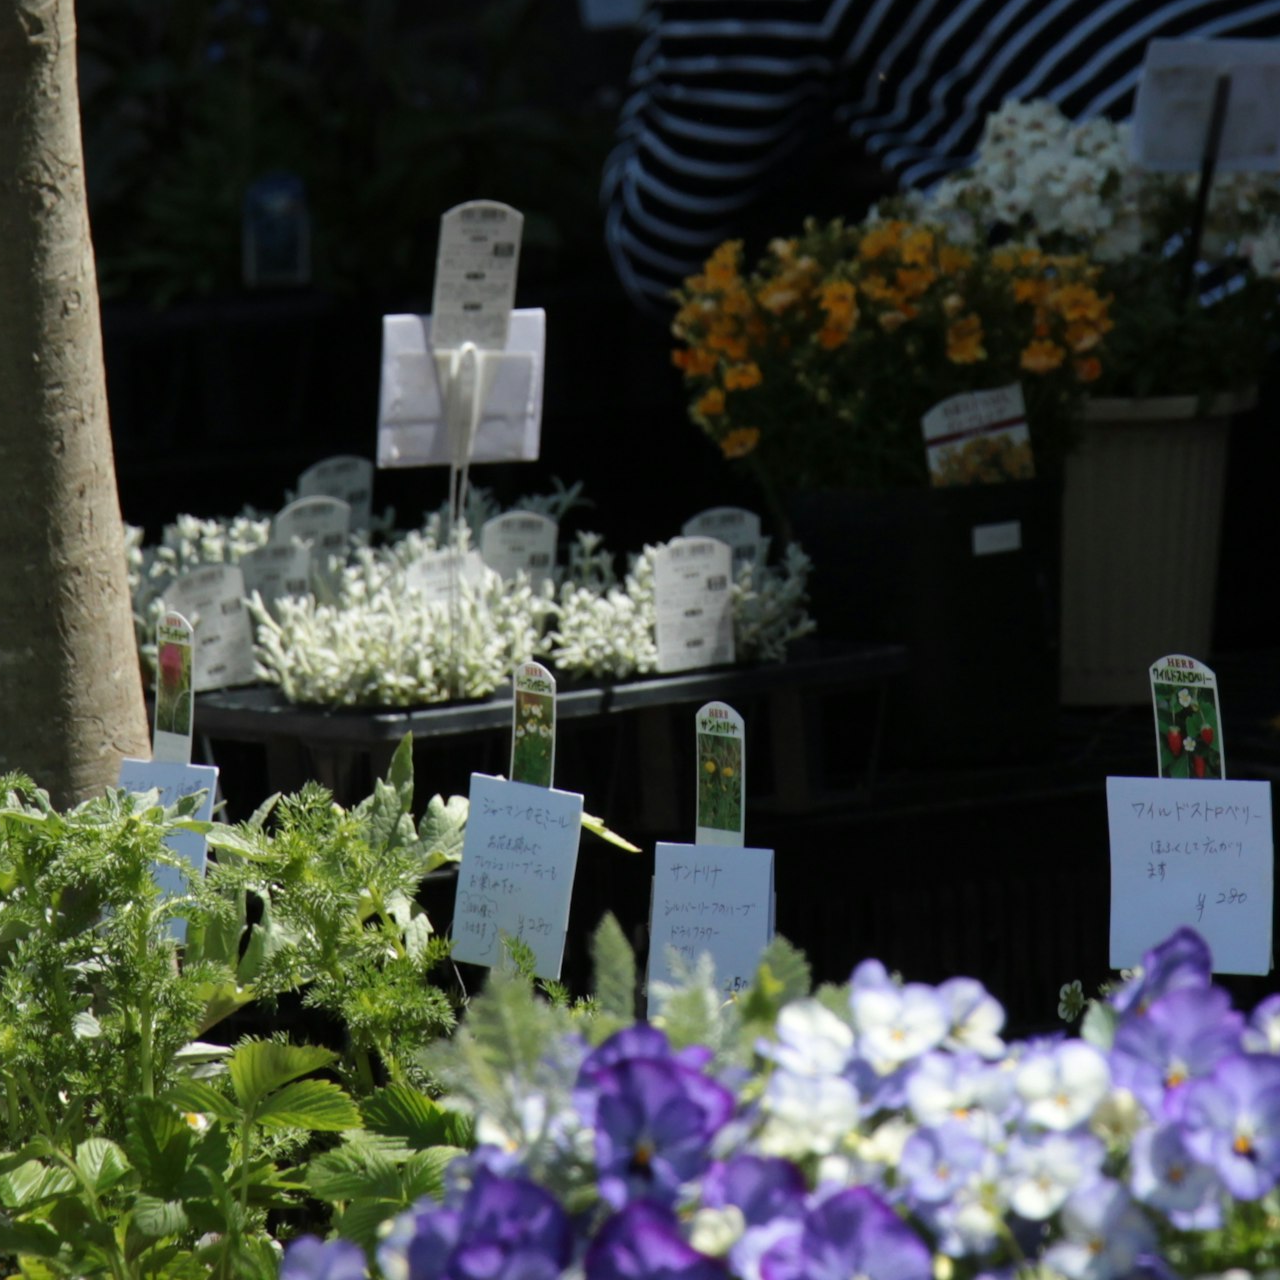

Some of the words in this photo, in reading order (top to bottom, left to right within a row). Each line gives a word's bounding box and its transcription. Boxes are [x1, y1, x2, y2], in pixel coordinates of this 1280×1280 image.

[1167, 657, 1194, 669] HERB
[1152, 668, 1212, 684] ワイルドストロベリー
[708, 708, 729, 719] HERB
[701, 718, 738, 734] サントリナ
[1131, 801, 1262, 824] ワイルドストロベリー
[1150, 836, 1243, 858] ほふくして広がり
[670, 863, 723, 888] サントリナ
[1146, 861, 1167, 881] ます
[664, 899, 757, 917] シルバーリーフのハーブ
[670, 925, 721, 942] ドライフラワー
